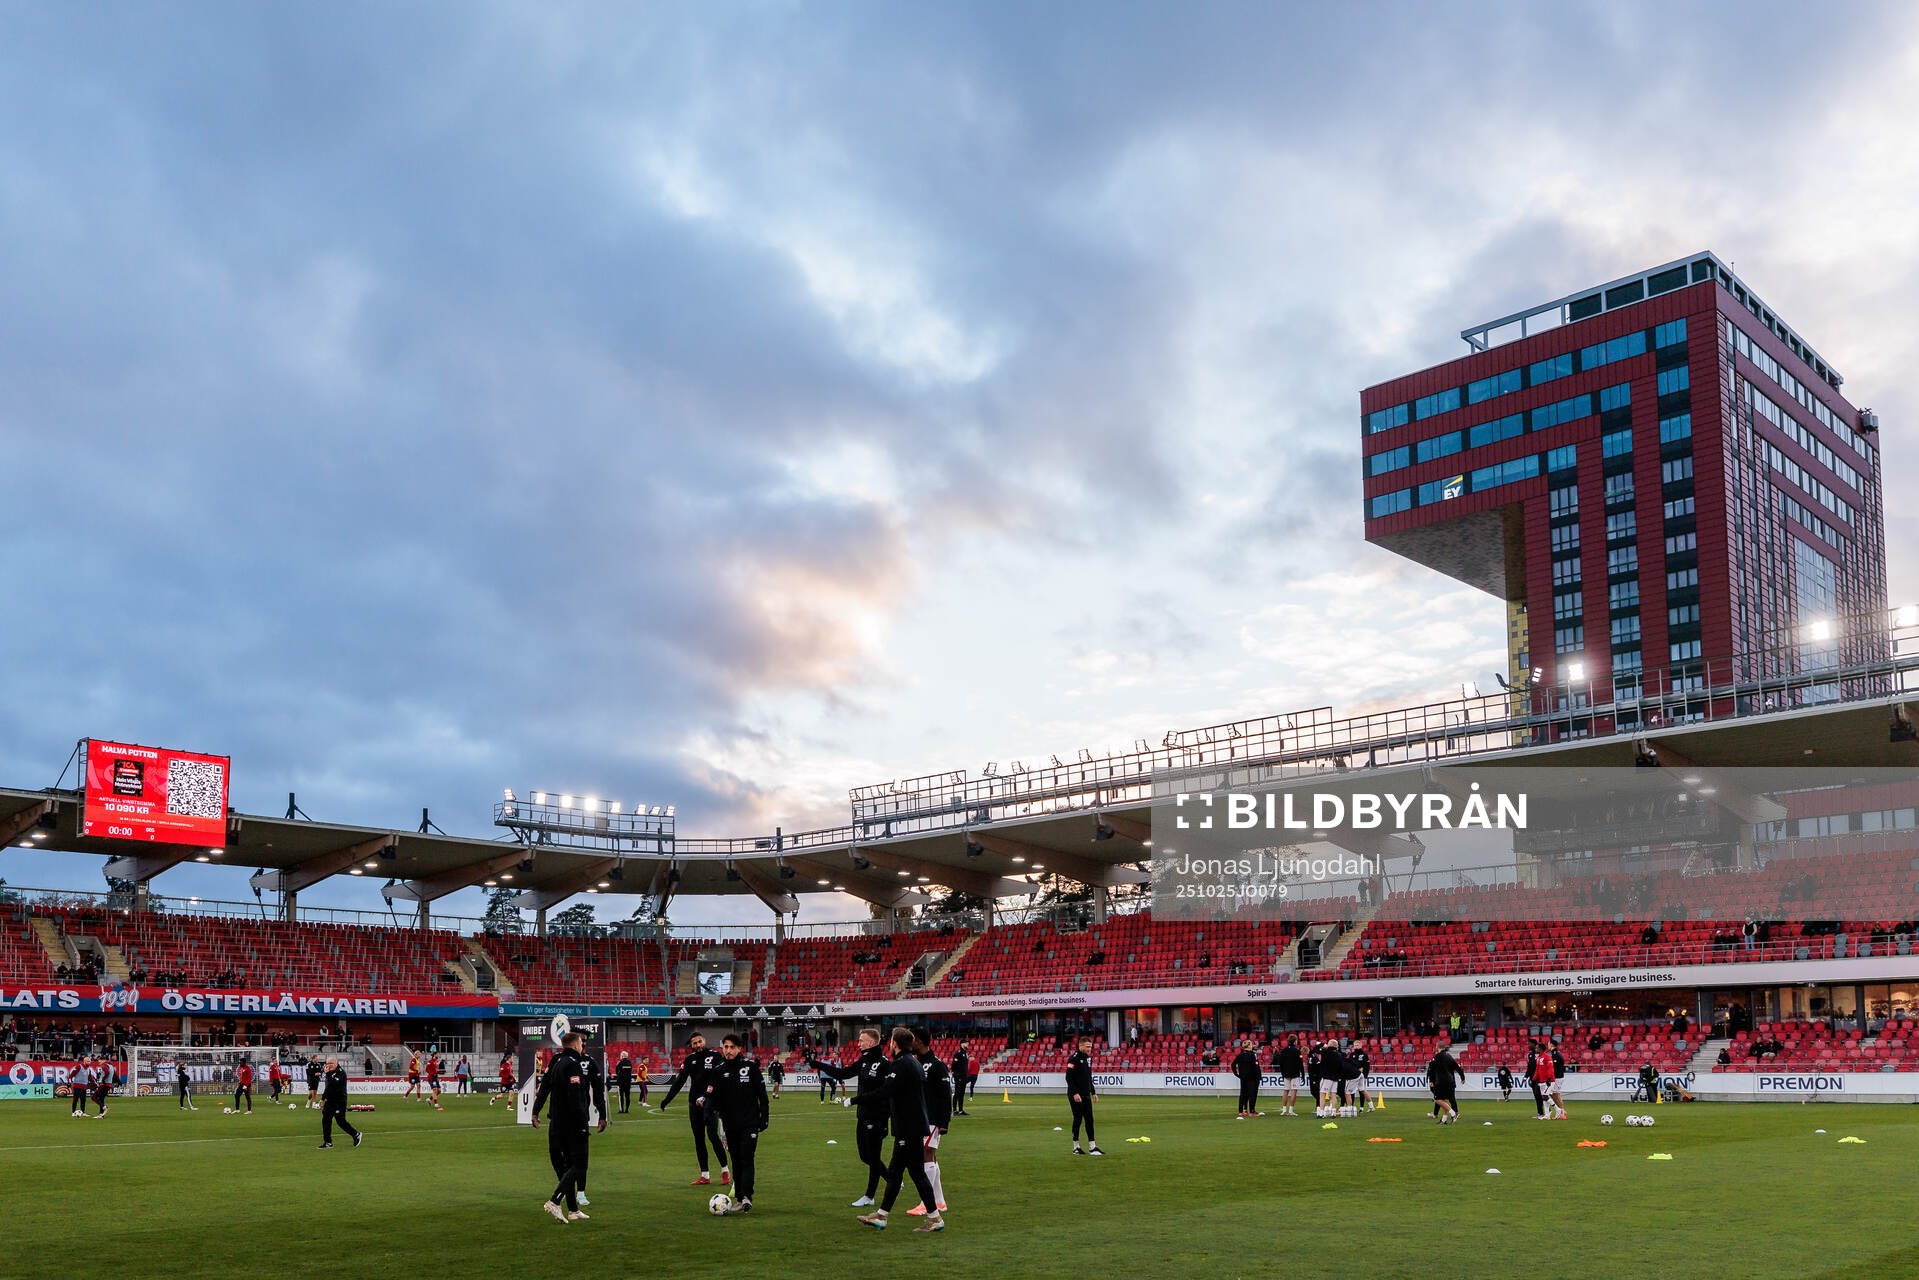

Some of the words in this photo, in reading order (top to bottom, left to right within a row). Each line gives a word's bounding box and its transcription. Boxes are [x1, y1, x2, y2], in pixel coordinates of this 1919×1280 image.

[1443, 485, 1462, 500] EY
[102, 746, 127, 755] HALVA
[128, 749, 158, 758] POTTEN
[104, 803, 115, 811] 10
[117, 804, 135, 813] 090
[137, 806, 149, 814] KR
[108, 826, 132, 836] 00:00
[1475, 979, 1516, 988] Smartare
[1518, 976, 1574, 987] fakturering.
[1577, 974, 1626, 985] Smidigare
[1629, 972, 1676, 983] business.
[99, 988, 139, 1008] 1930
[1247, 988, 1267, 998] Spiris
[161, 989, 407, 1014] ÖSTERLÄKTAREN
[971, 999, 996, 1008] Smartare
[1028, 997, 1058, 1006] Smidigare
[1059, 996, 1087, 1004] business.
[534, 1007, 544, 1015] ger
[544, 1006, 575, 1015] fastigheter
[620, 1007, 649, 1016] bravida
[522, 1026, 547, 1035] UNIBET
[999, 1075, 1040, 1085] PREMON
[1165, 1076, 1214, 1086] PREMON
[1367, 1076, 1427, 1088] PREMON
[1759, 1077, 1843, 1090] PREMON
